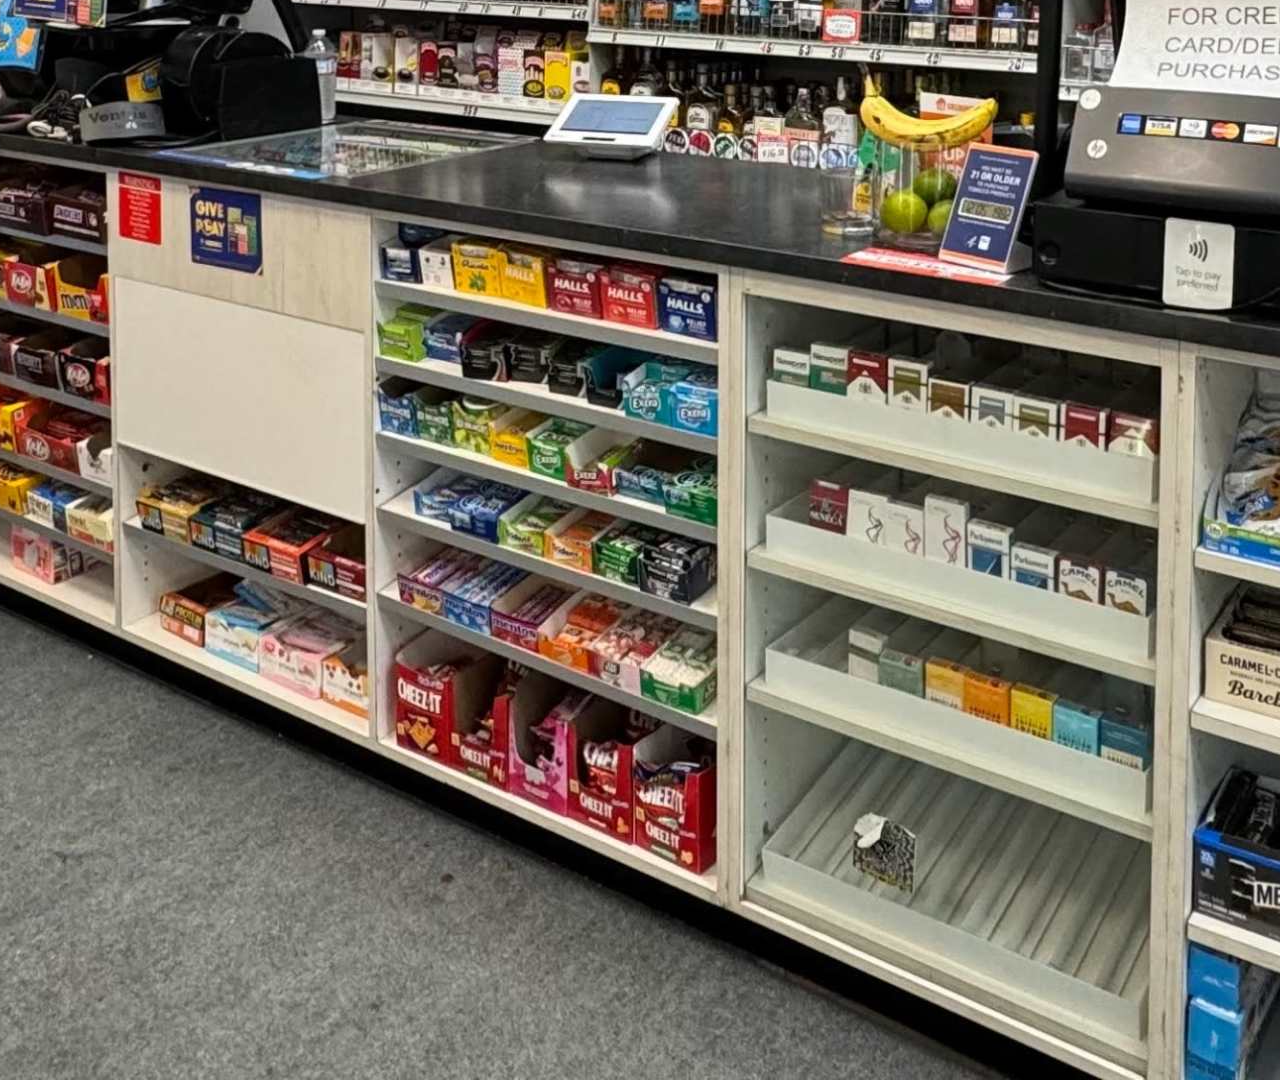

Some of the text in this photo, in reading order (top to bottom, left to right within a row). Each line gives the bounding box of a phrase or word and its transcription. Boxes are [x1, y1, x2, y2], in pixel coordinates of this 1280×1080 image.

[1167, 6, 1218, 27] FOR
[194, 200, 225, 219] GIVE
[505, 268, 536, 283] HALLS
[1204, 271, 1223, 283] pay
[554, 277, 590, 295] HALLS
[1176, 277, 1219, 293] preferred
[607, 287, 645, 304] HALLS
[666, 296, 704, 315] HALLS
[192, 532, 216, 549] KIND
[244, 553, 269, 570] KIND
[308, 569, 336, 588] KIND
[1060, 568, 1100, 588] CAMEL
[1106, 578, 1147, 599] CAMEL
[492, 618, 537, 639] mentos
